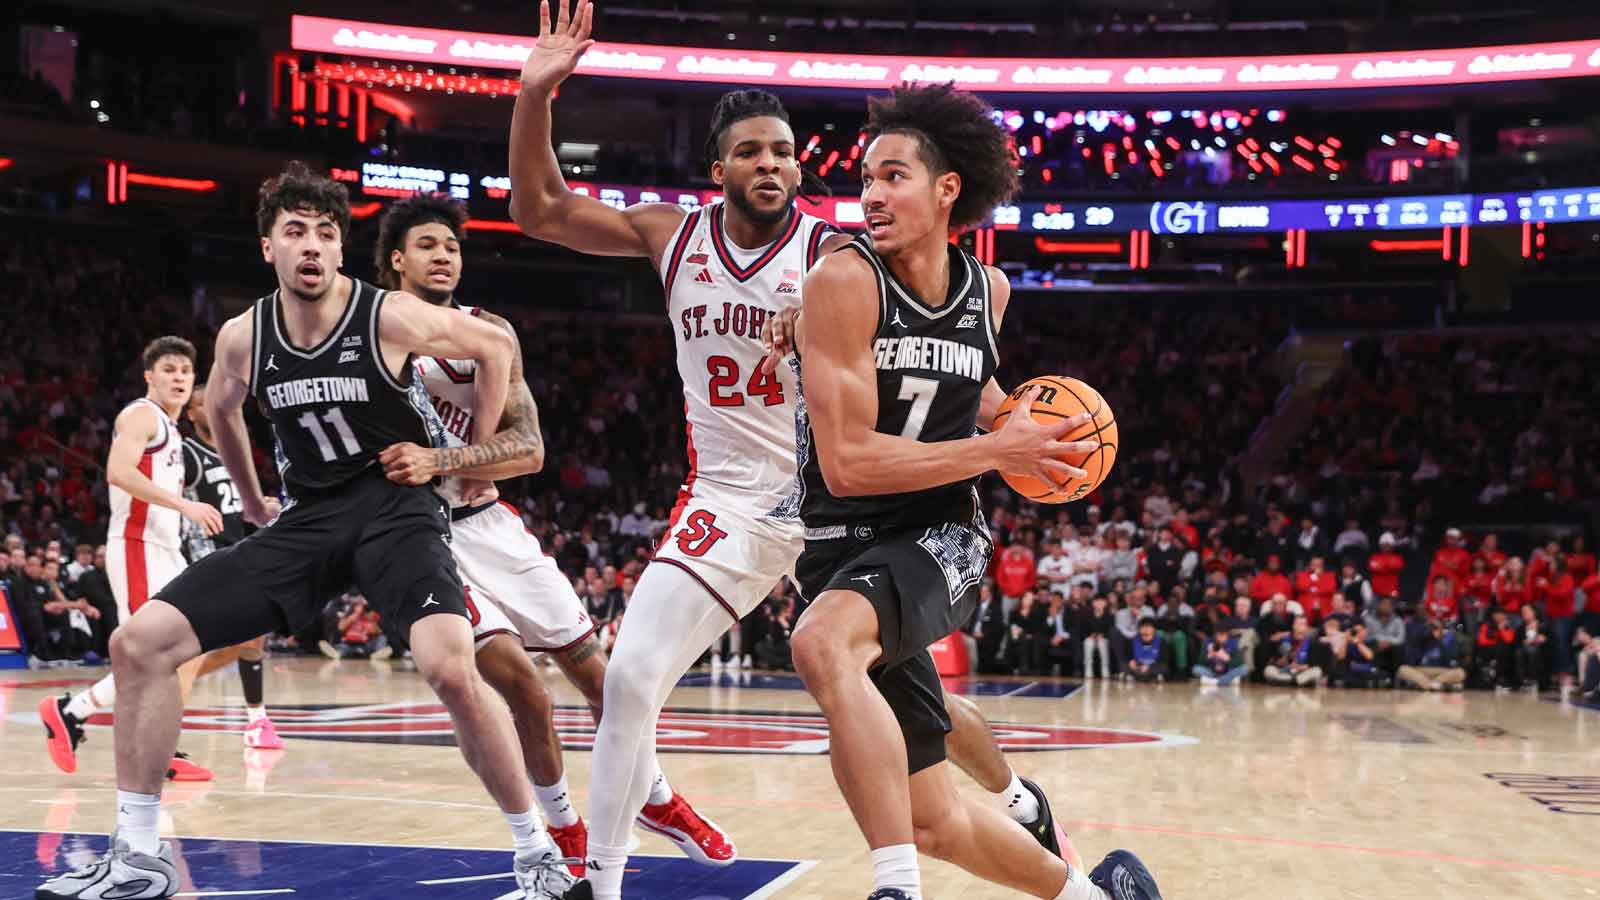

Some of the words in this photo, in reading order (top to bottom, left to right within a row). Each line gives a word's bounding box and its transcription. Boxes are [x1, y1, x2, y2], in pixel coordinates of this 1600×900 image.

[681, 304, 709, 341] ST.
[706, 355, 785, 407] 24
[873, 335, 984, 383] GEORGETOWN
[265, 376, 370, 409] GEORGETOWN
[897, 374, 940, 442] 7
[297, 406, 363, 463] 11
